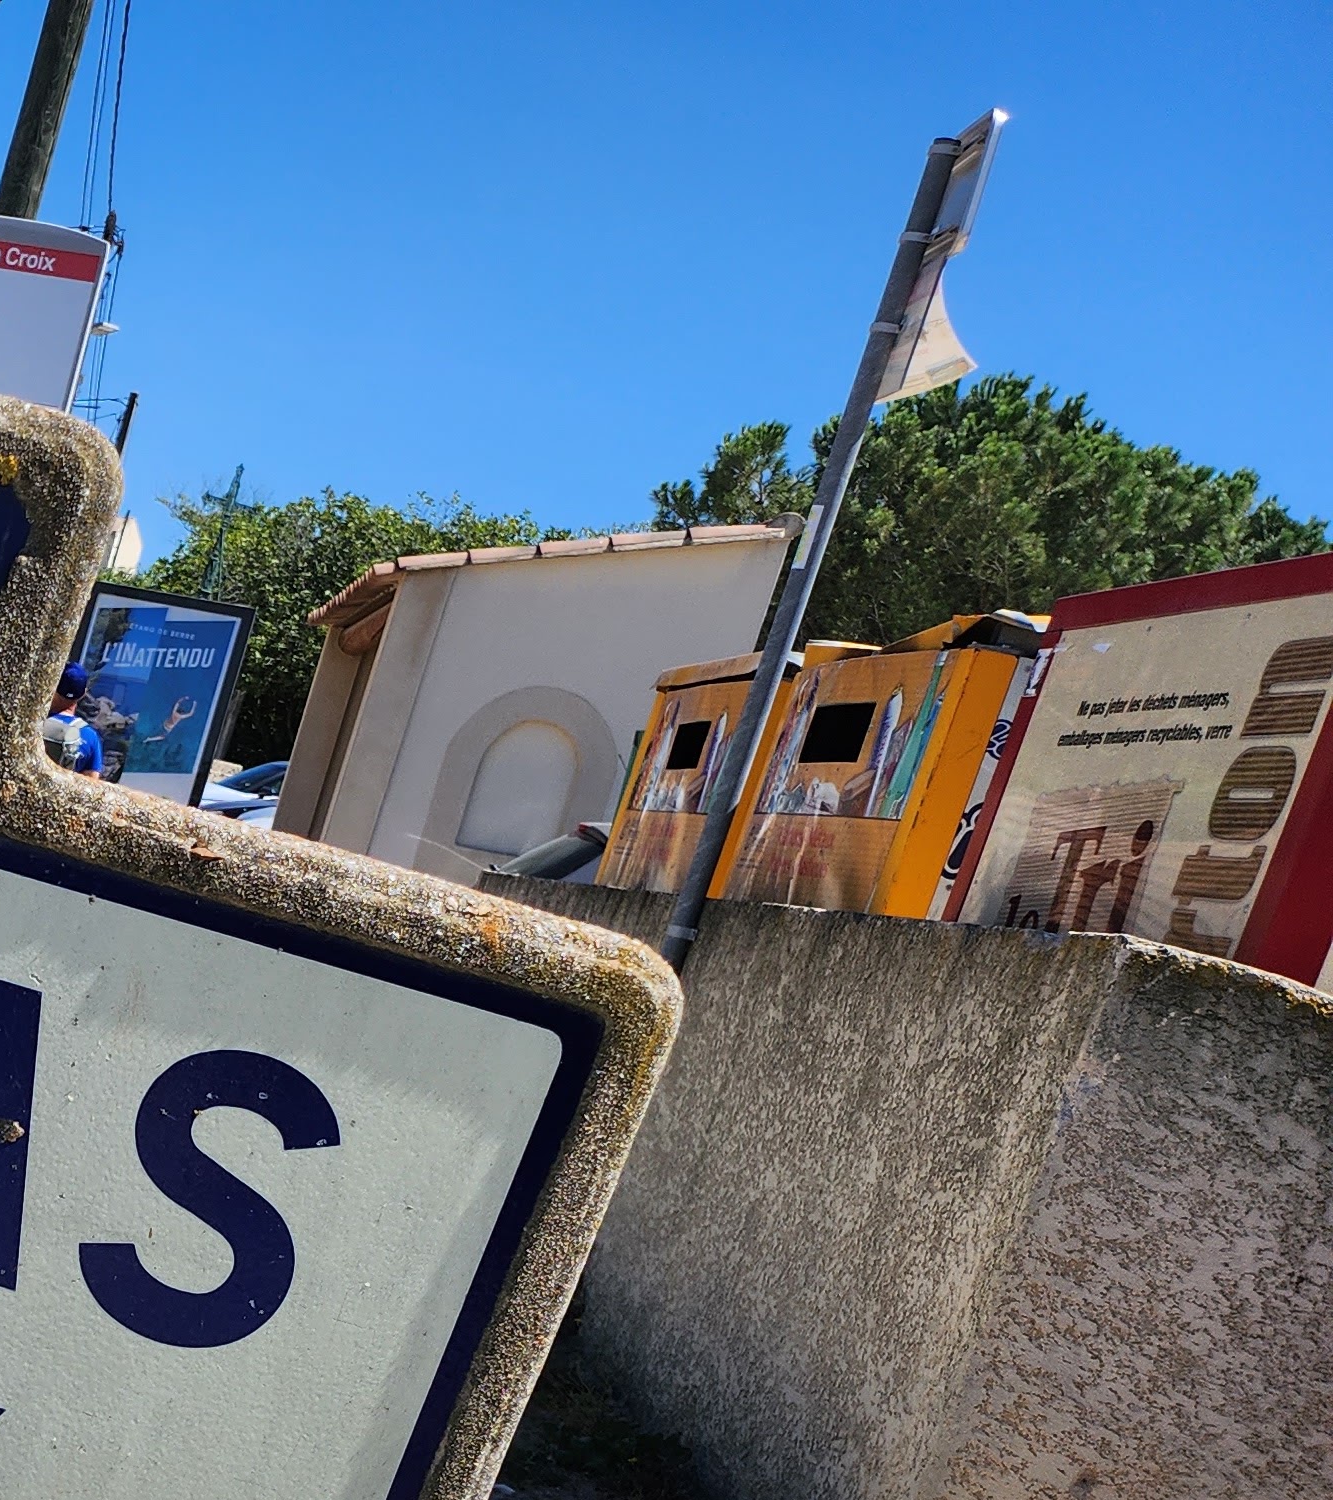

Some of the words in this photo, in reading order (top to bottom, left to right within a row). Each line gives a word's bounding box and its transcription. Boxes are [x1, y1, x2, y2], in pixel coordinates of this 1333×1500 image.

[5, 247, 57, 272] Croix
[170, 630, 195, 640] BERRE
[101, 641, 215, 667] L'INATTENDU
[1077, 700, 1091, 717] Ne
[1088, 701, 1107, 719] pas
[1104, 698, 1129, 718] jeter
[1126, 696, 1142, 713] les
[1141, 692, 1179, 712] déchets
[1178, 690, 1231, 713] ménagers,
[1057, 729, 1105, 749] emballages
[1103, 727, 1147, 748] ménagers
[1146, 723, 1204, 748] recyclables,
[1204, 723, 1234, 741] verre
[1044, 819, 1156, 935] Tri
